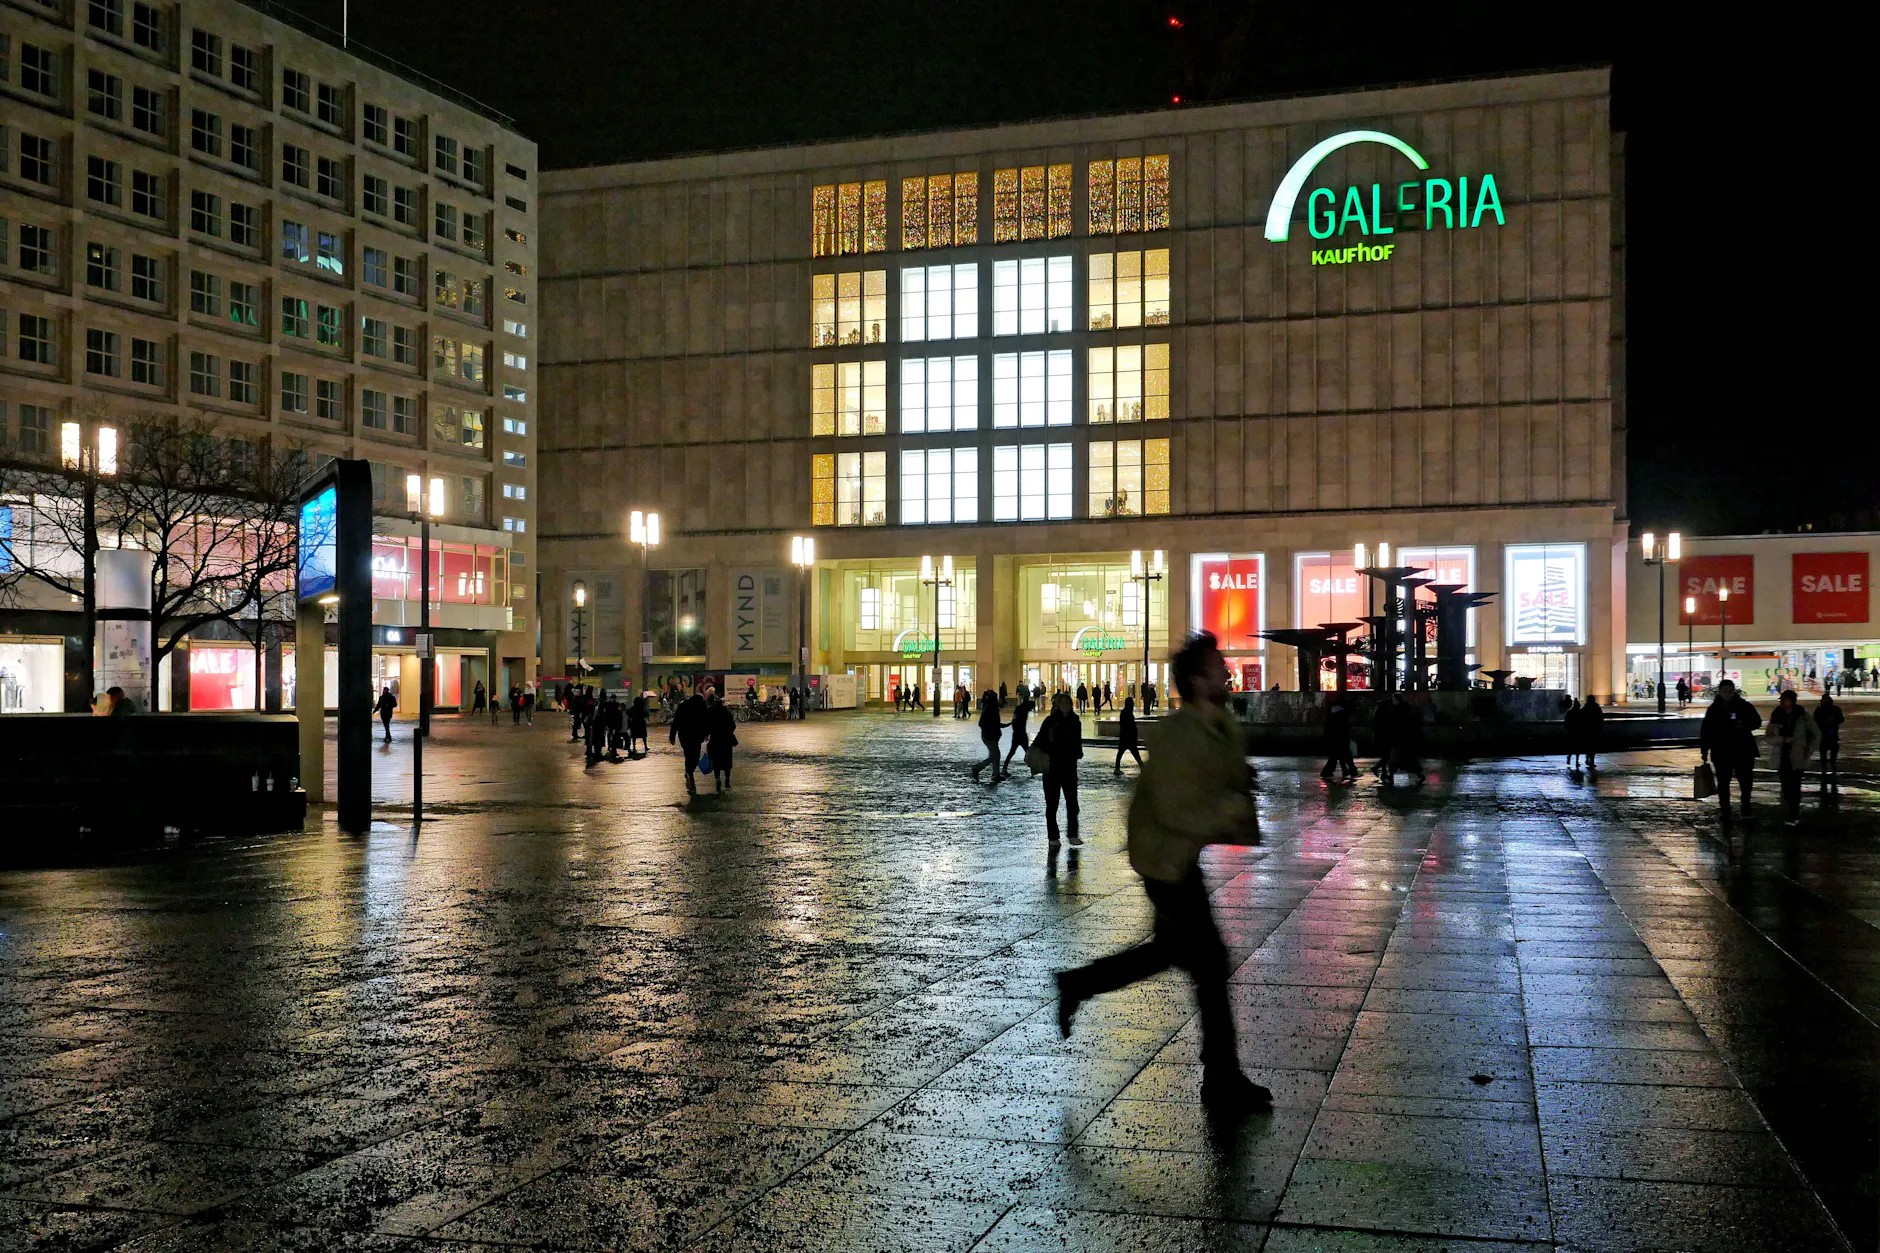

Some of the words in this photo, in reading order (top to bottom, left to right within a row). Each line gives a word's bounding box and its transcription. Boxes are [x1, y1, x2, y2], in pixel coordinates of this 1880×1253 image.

[1308, 174, 1505, 239] GALERIA
[1209, 573, 1257, 590] SALE
[1309, 578, 1357, 594] SALE
[1687, 577, 1746, 595] SALE
[1801, 574, 1862, 593] SALE
[1520, 591, 1569, 607] SALE
[738, 575, 754, 651] MYND
[1082, 637, 1126, 650] GALERIA
